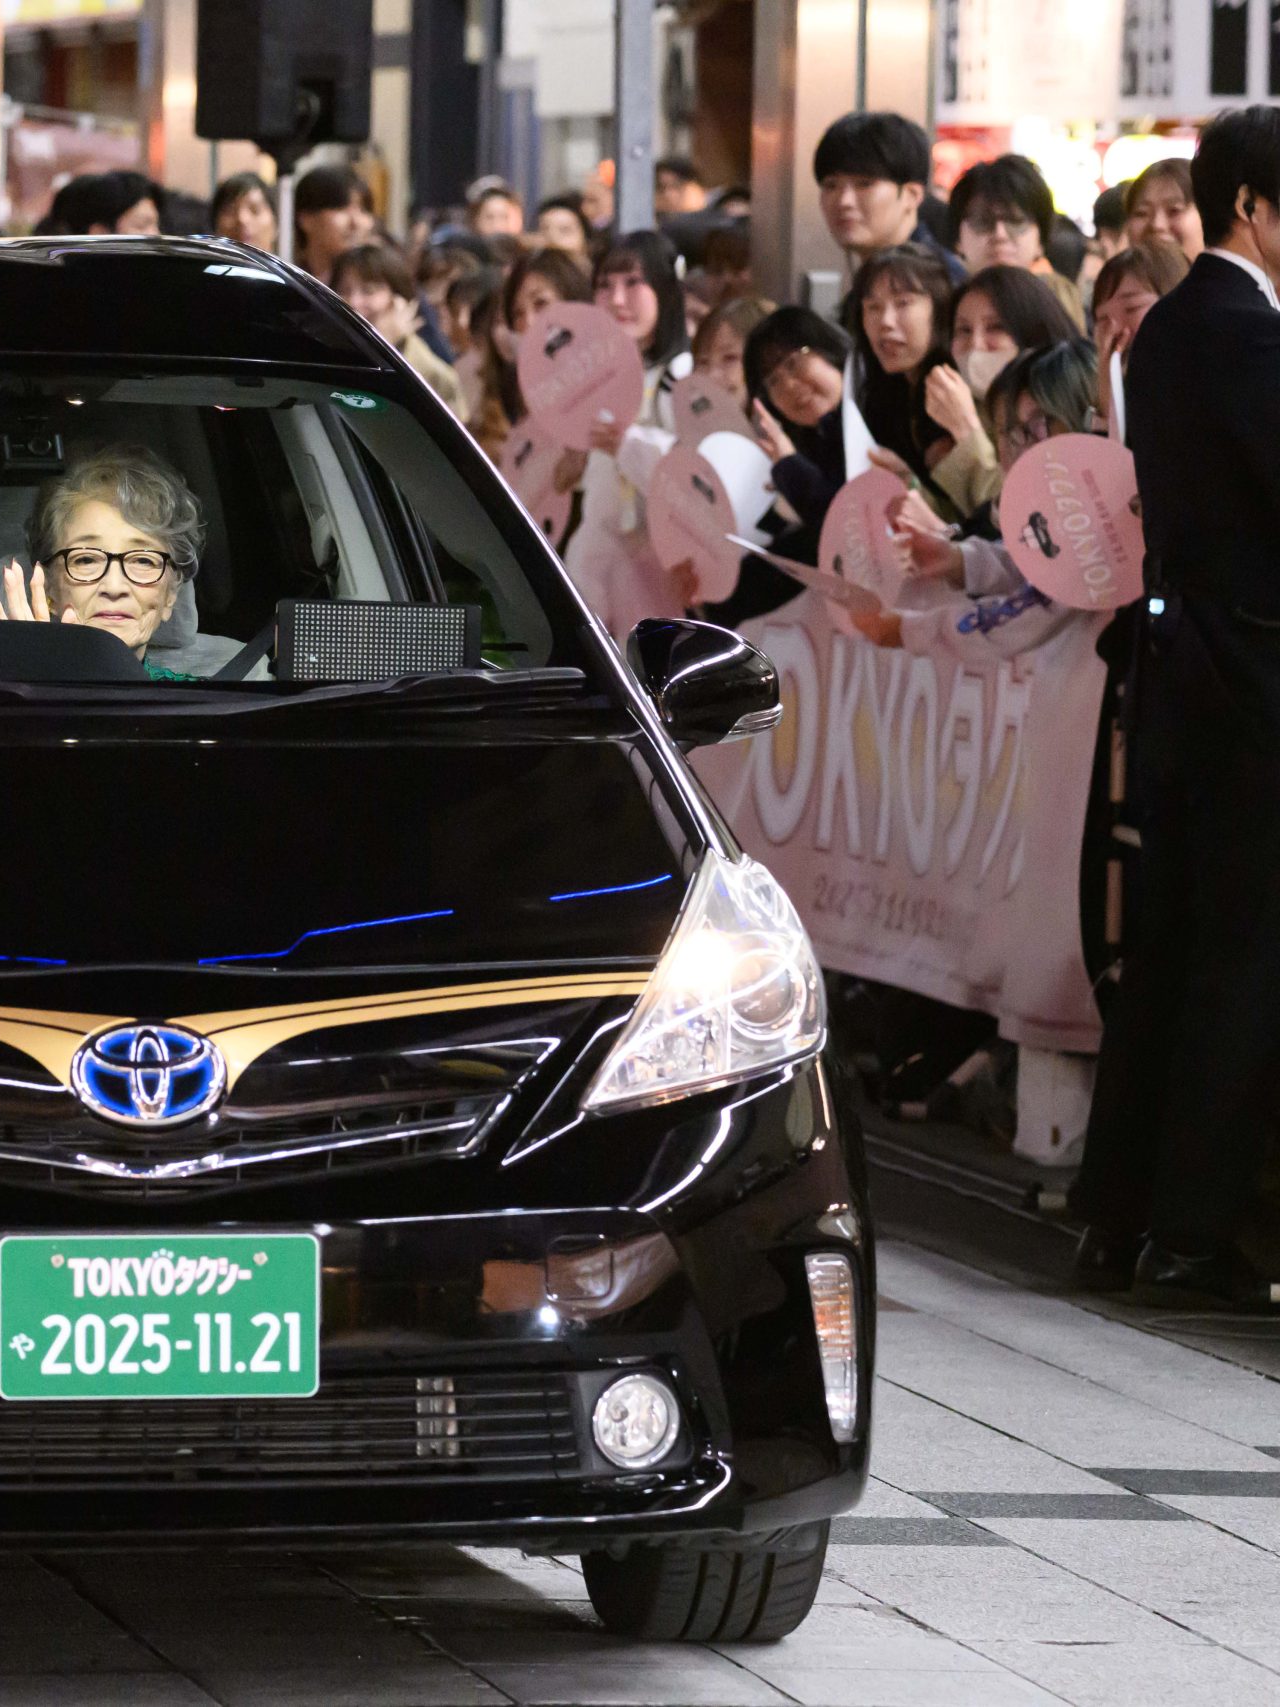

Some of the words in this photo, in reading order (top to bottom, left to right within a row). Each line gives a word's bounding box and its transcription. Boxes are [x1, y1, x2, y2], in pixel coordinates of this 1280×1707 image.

[67, 1253, 252, 1297] TOKYOタクシー
[40, 1311, 301, 1375] 2025-11.21
